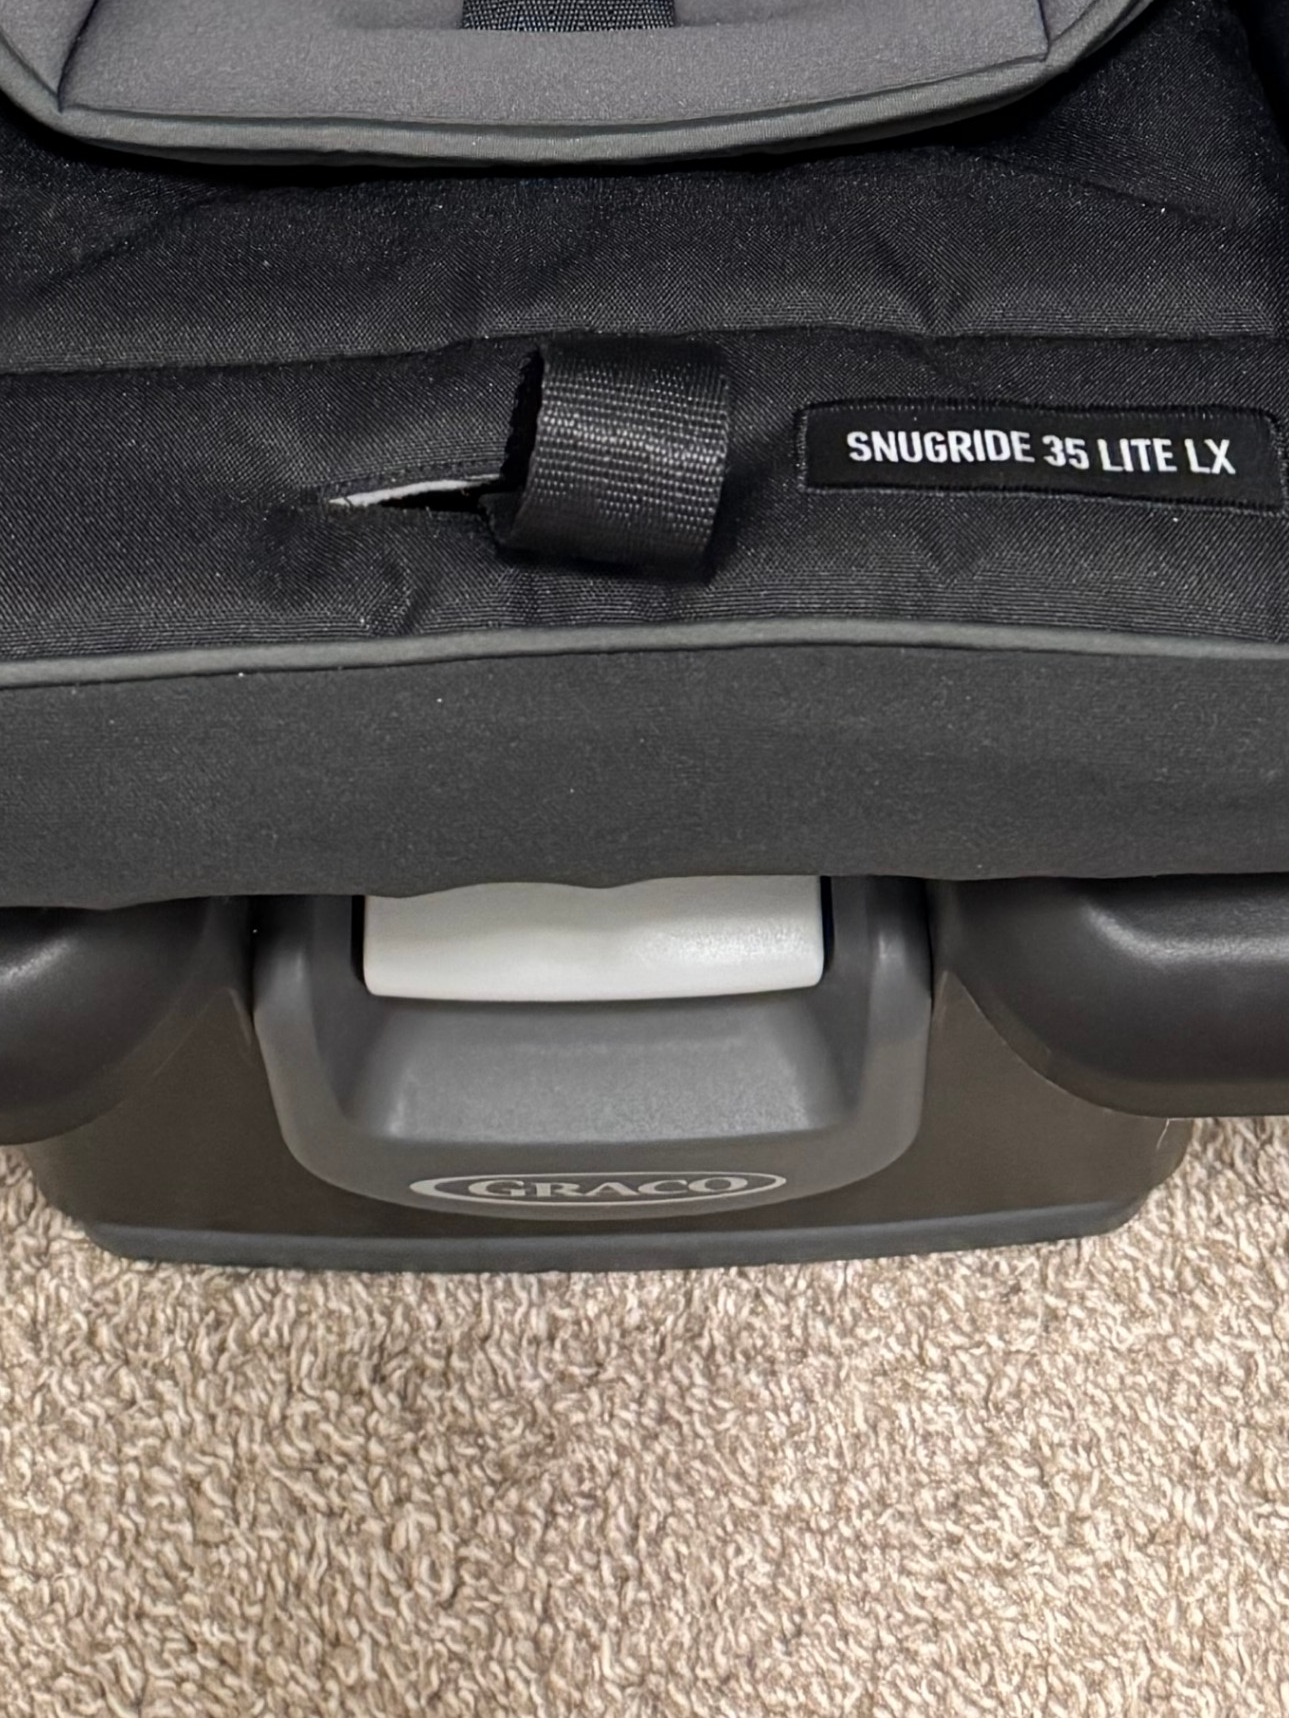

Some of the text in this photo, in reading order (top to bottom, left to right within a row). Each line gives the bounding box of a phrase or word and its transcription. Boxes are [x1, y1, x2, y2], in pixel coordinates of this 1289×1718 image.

[846, 429, 1236, 475] SNUGRIDE 35 LITE LX
[467, 1176, 749, 1199] GRACO
